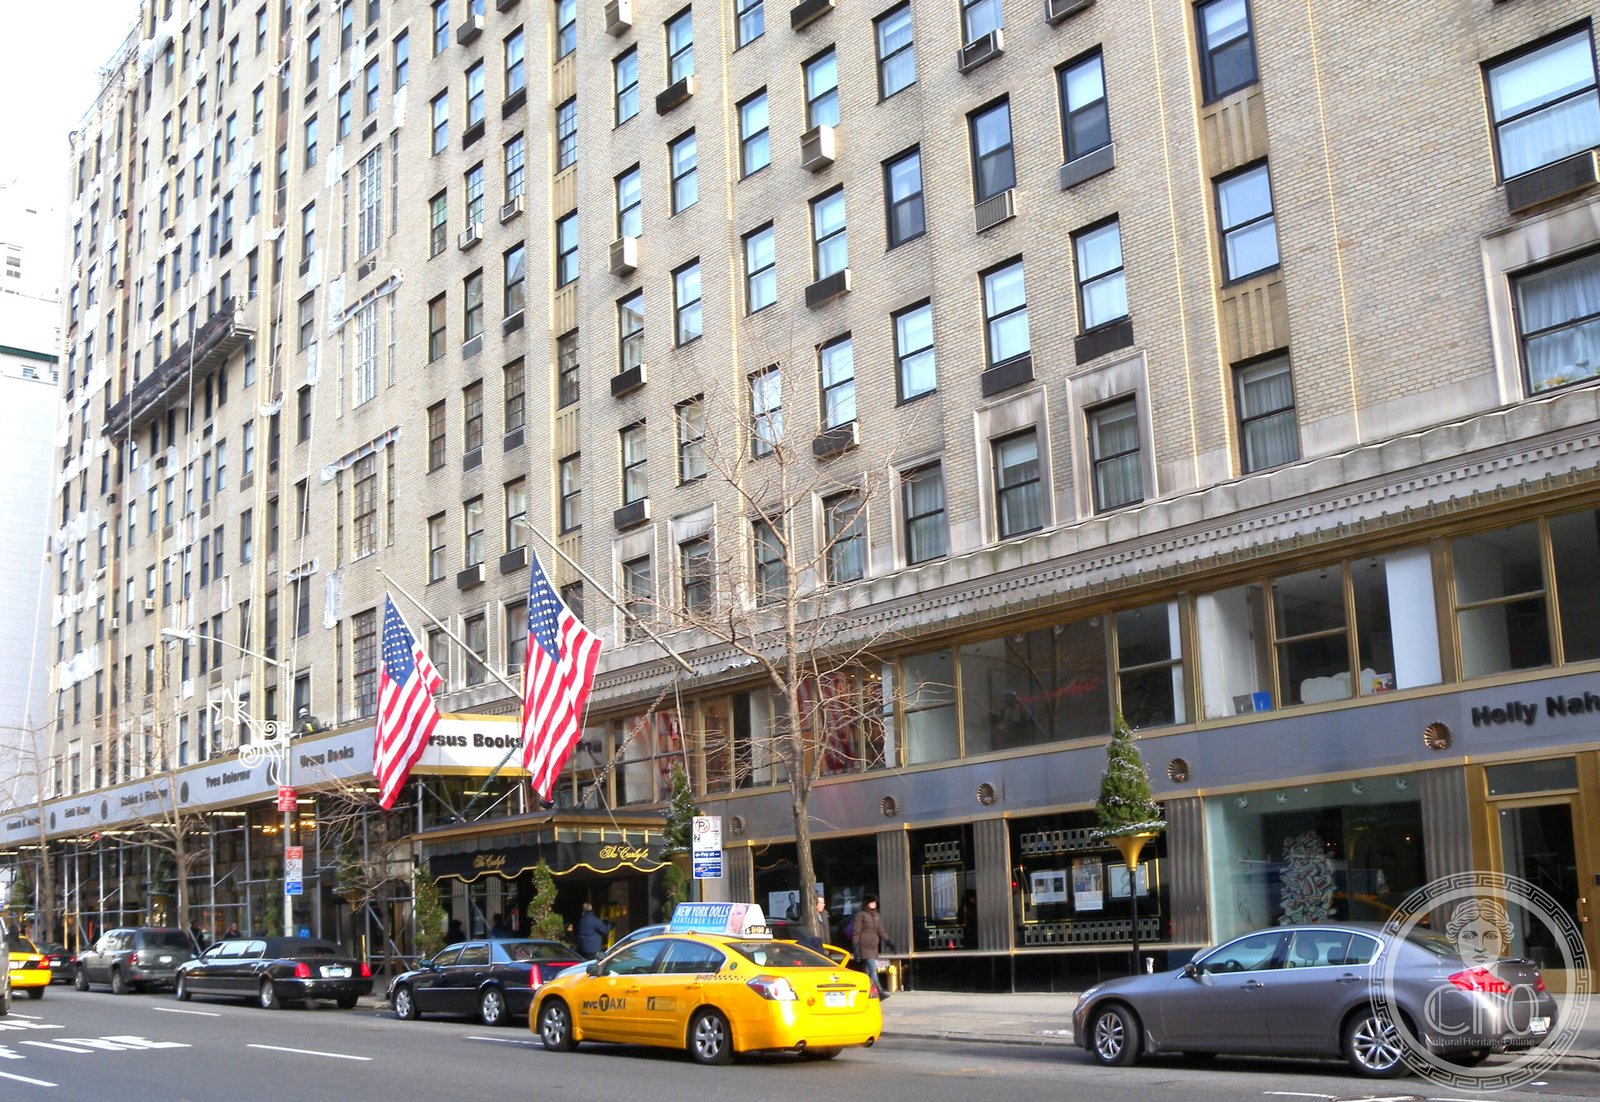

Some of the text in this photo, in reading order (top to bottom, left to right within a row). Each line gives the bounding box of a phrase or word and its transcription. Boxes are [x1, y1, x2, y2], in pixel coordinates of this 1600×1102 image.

[428, 733, 524, 749] rsus Books
[675, 905, 731, 918] NEW YORK DOLLS
